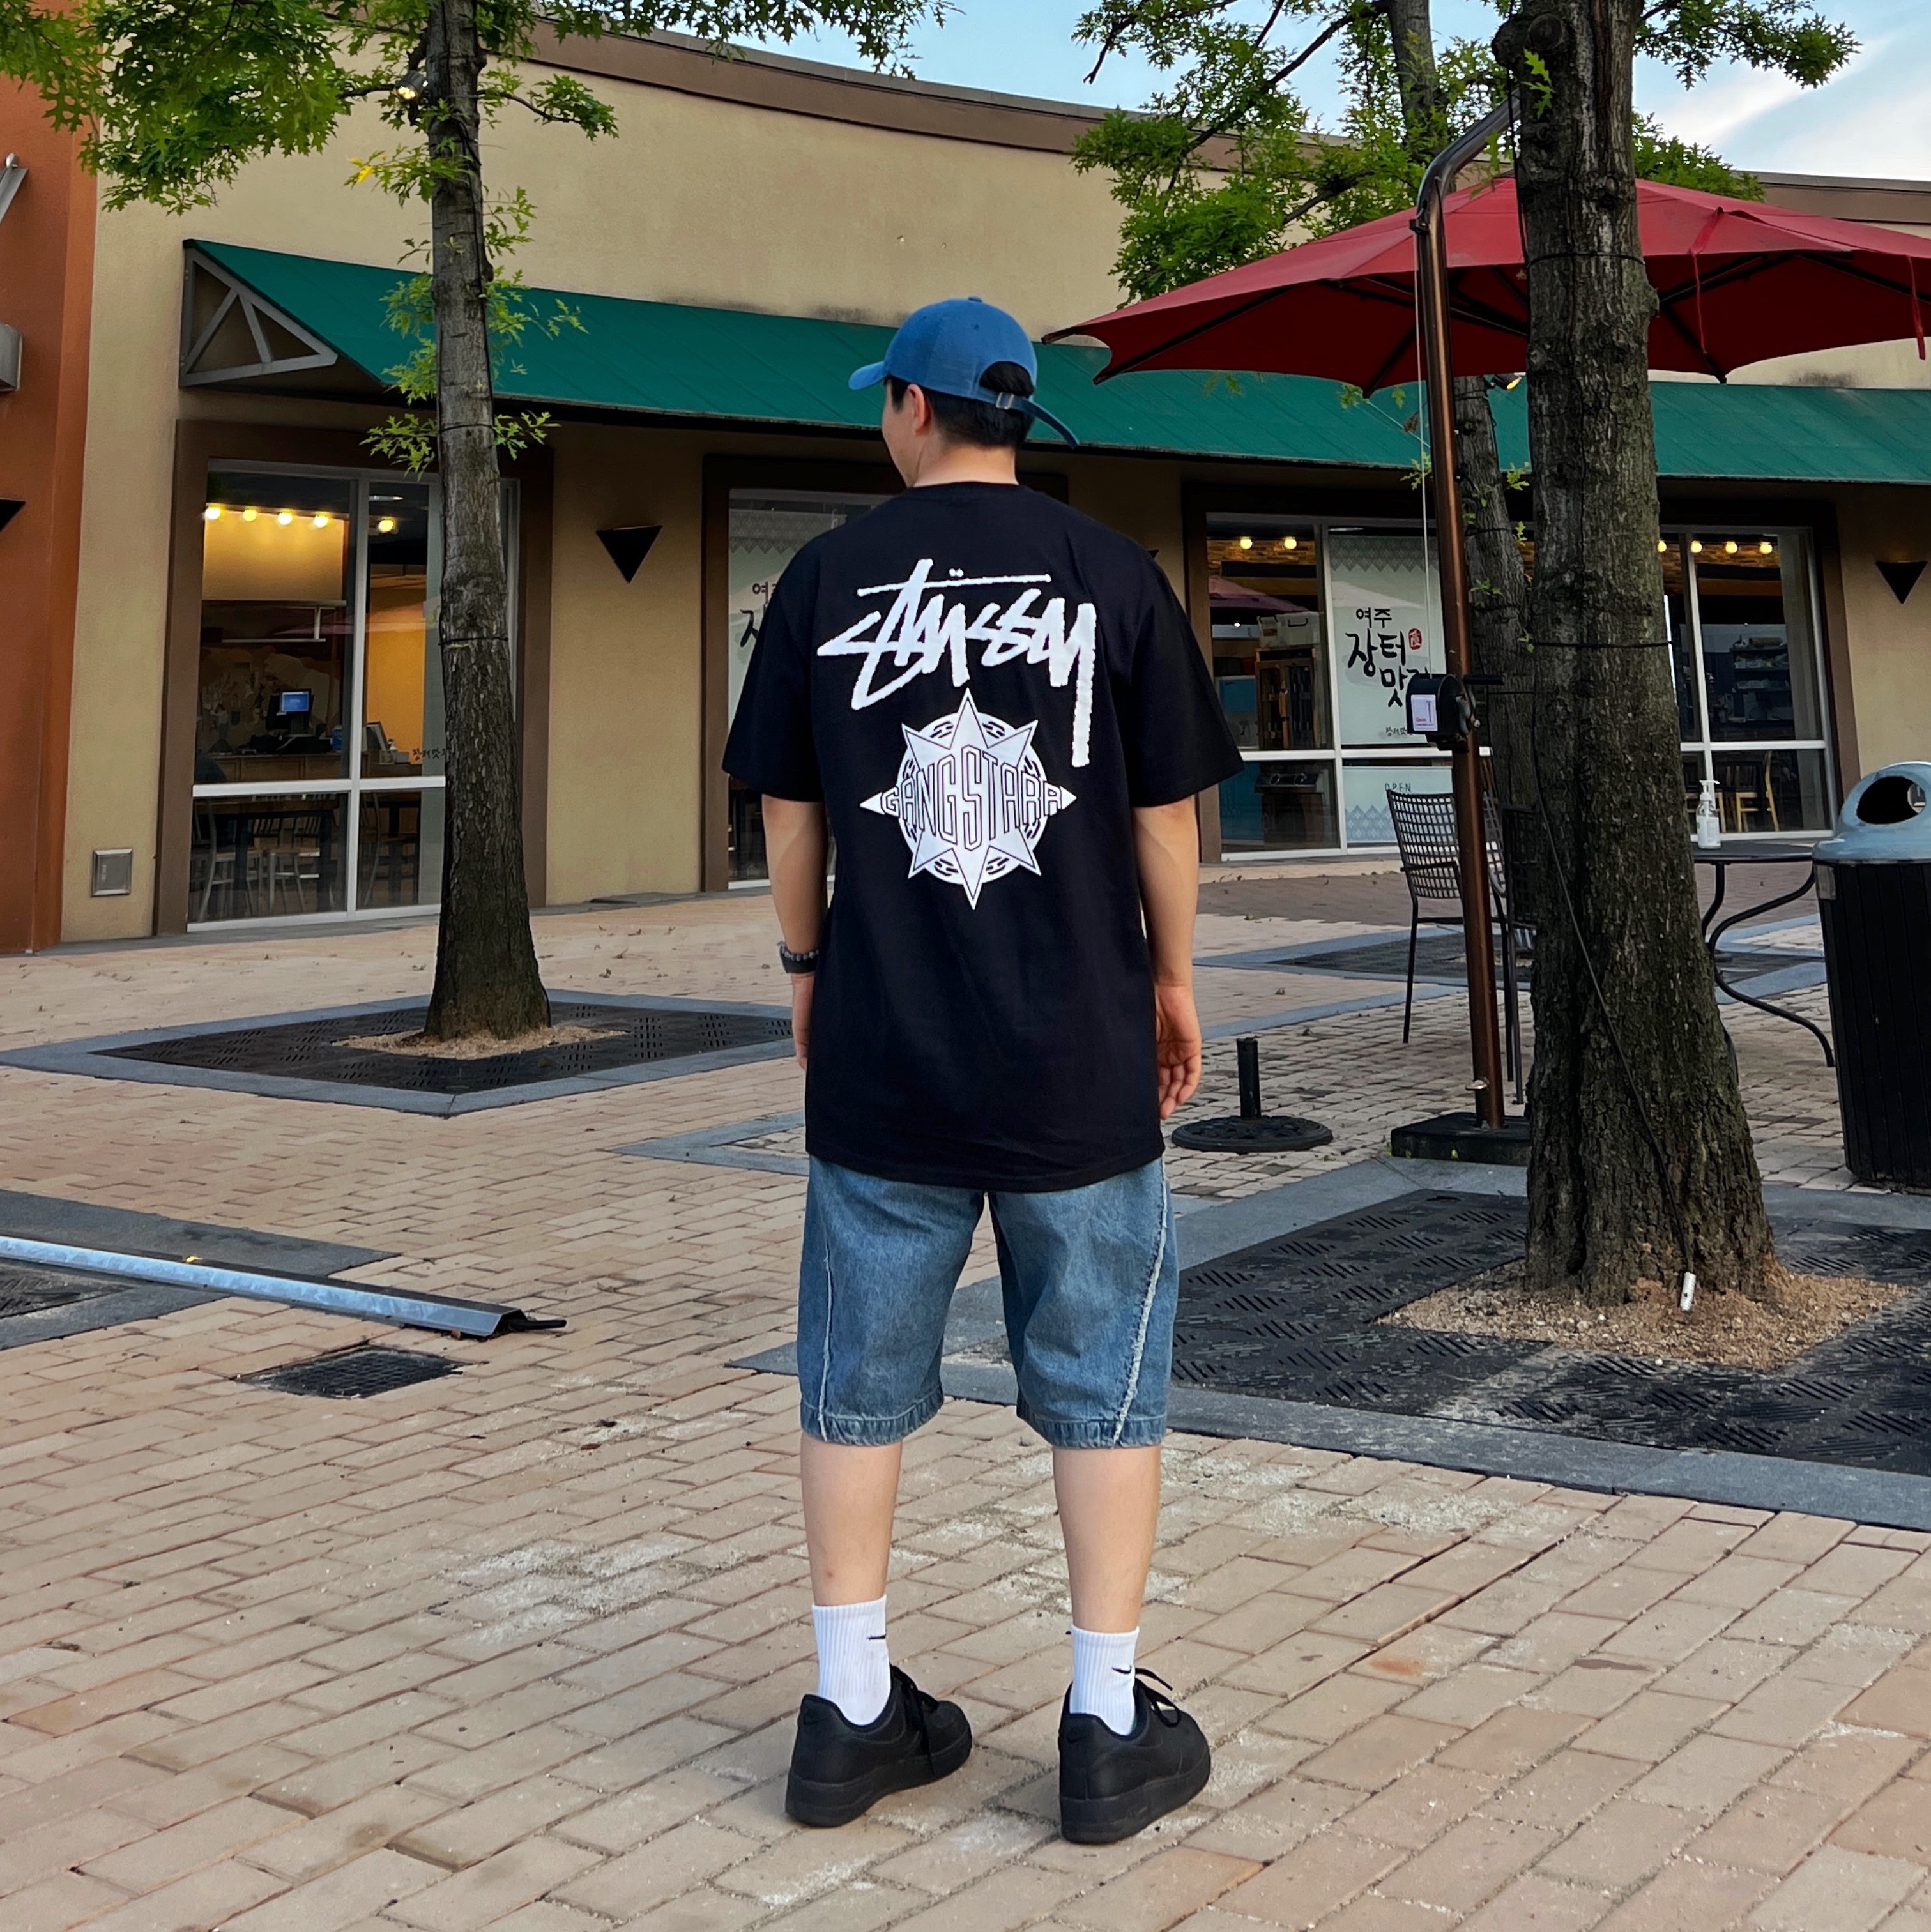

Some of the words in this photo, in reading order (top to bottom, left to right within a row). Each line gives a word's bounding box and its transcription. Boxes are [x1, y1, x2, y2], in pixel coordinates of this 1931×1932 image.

[752, 581, 776, 604] 여
[1355, 607, 1392, 628] 여주
[1345, 628, 1406, 677] 장터
[1380, 666, 1428, 708] 맛
[1385, 727, 1408, 736] 장터맛
[1385, 783, 1411, 792] OPEN
